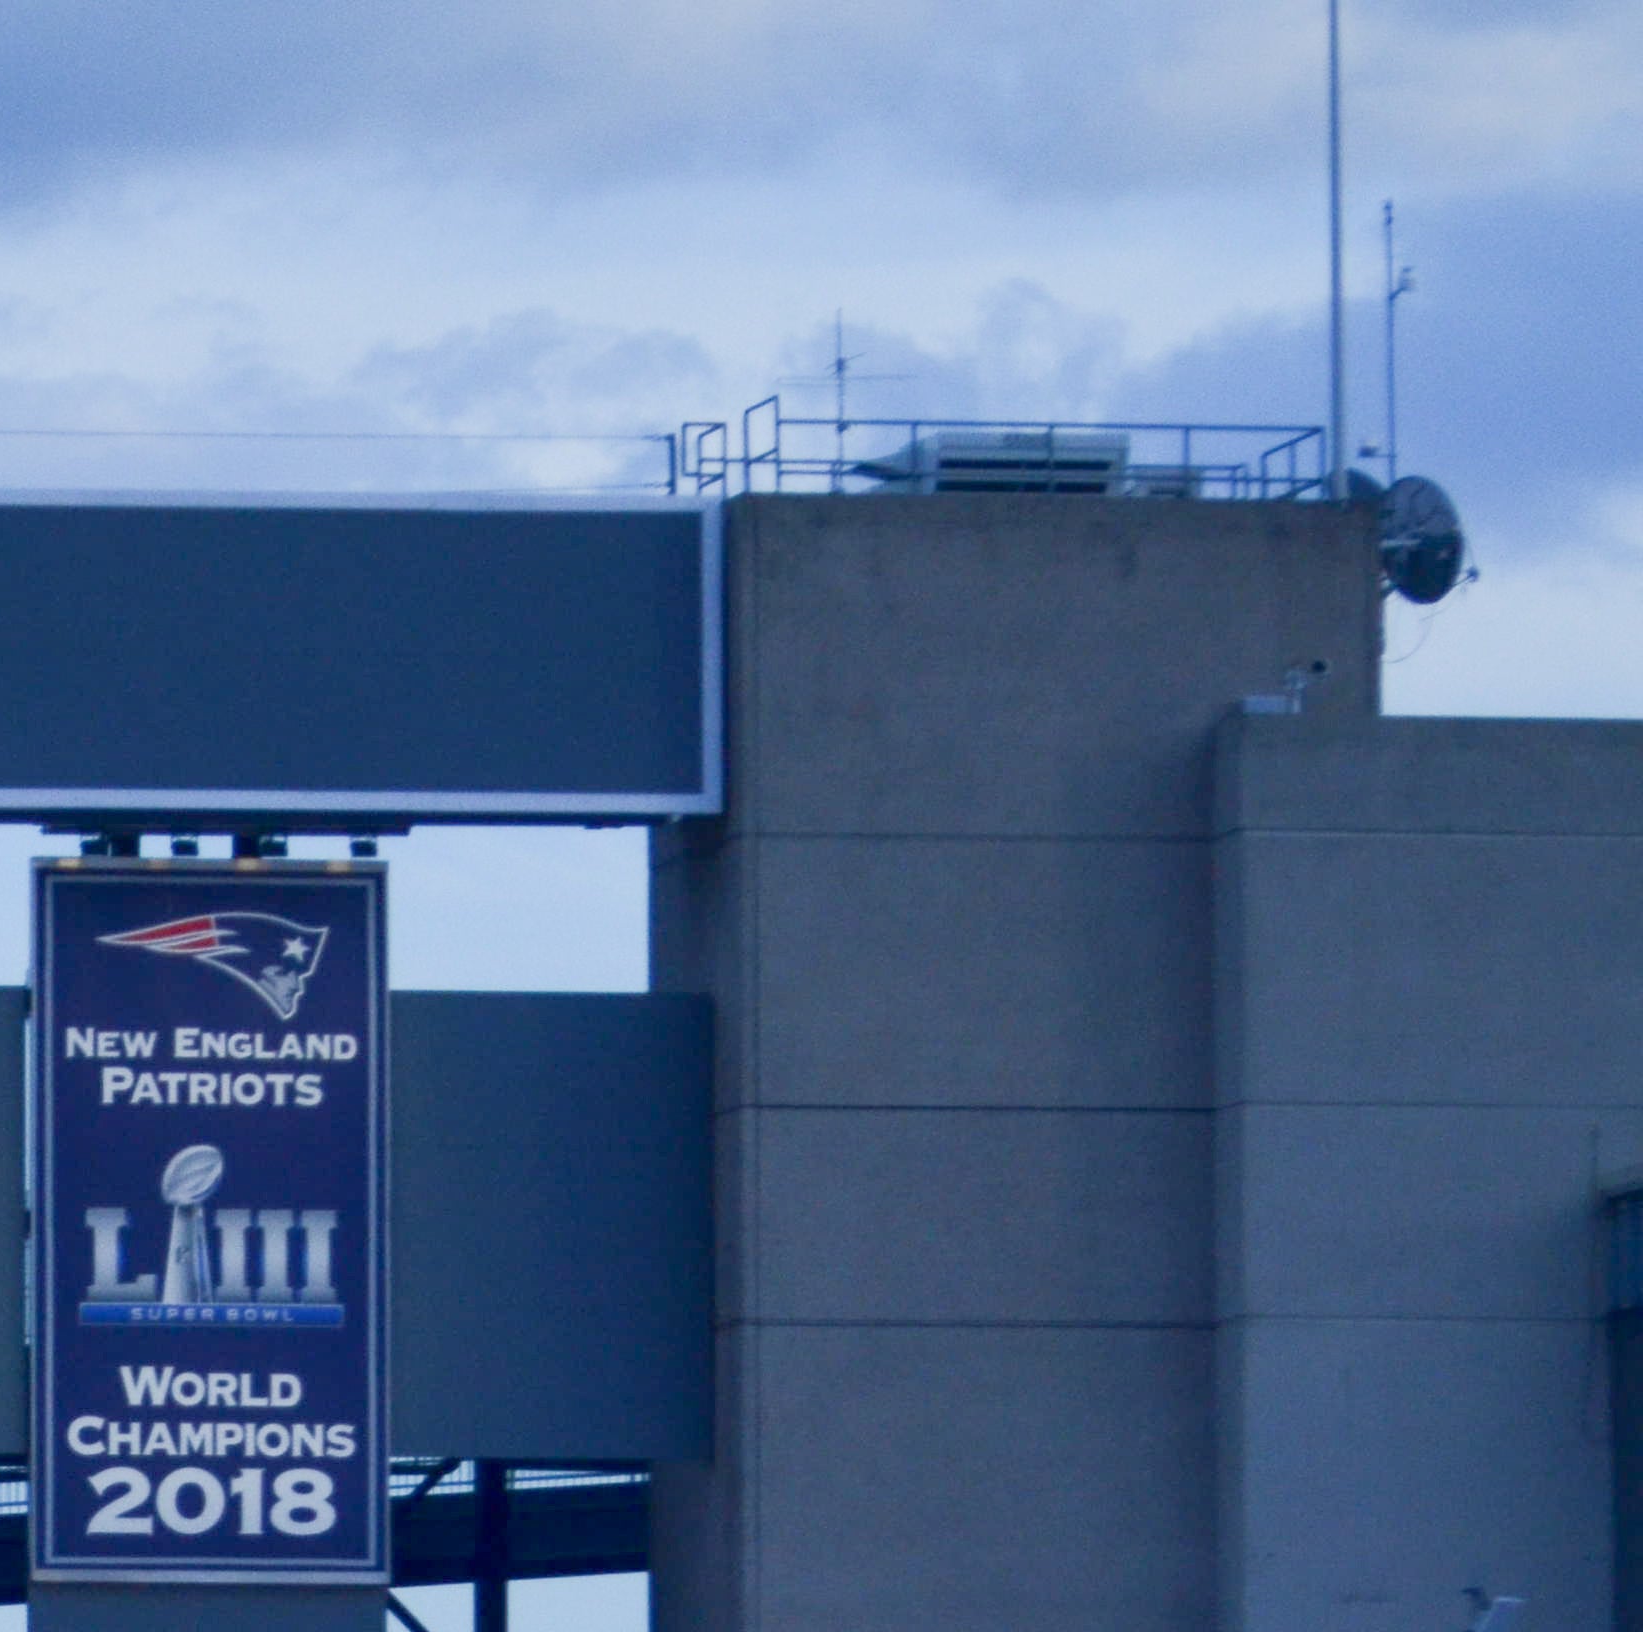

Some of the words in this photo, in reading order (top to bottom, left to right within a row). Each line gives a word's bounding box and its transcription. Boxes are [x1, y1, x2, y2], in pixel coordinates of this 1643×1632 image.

[66, 1027, 157, 1058] NEW
[174, 1028, 357, 1060] ENGLAND
[102, 1067, 323, 1106] PATRIOTS
[130, 1307, 215, 1321] SUPER
[226, 1308, 295, 1322] BOWL
[120, 1366, 302, 1407] WORLD
[67, 1416, 355, 1458] CHAMPIONS
[87, 1467, 336, 1535] 2018
